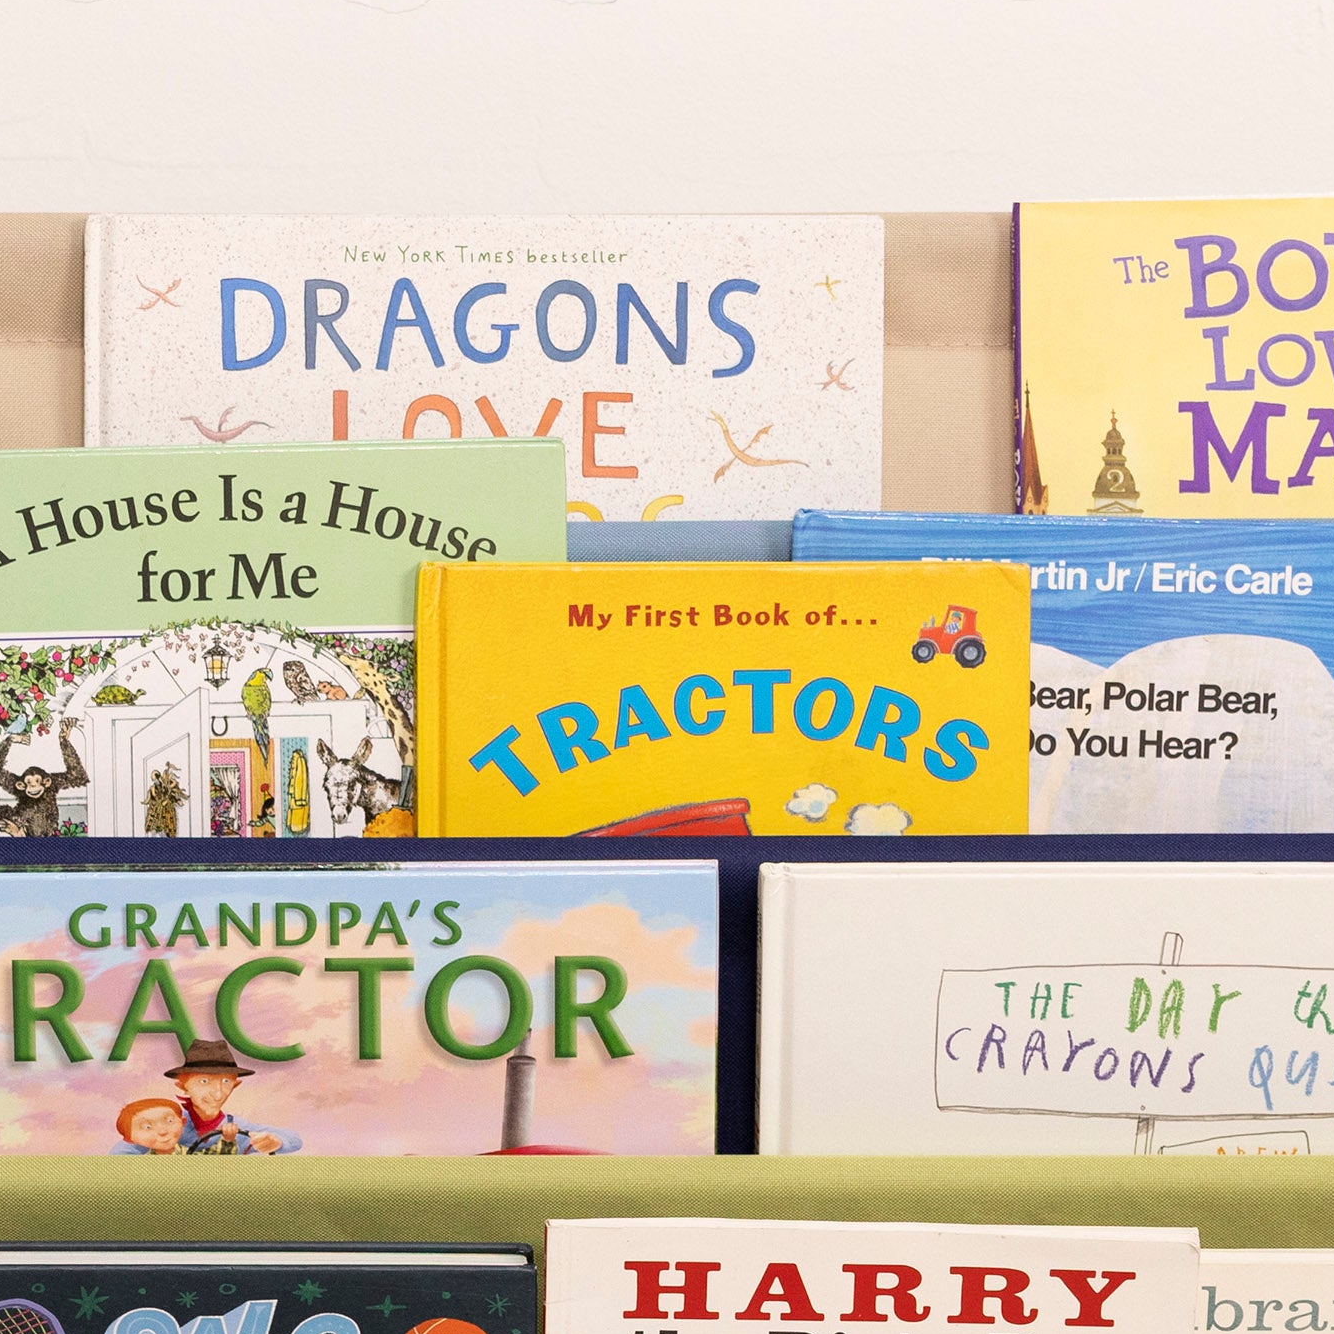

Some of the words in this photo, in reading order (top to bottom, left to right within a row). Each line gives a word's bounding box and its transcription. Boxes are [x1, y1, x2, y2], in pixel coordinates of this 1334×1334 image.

[527, 248, 627, 264] bestseller
[1113, 255, 1170, 285] The
[219, 277, 761, 379] DRAGONS
[1107, 469, 1126, 493] 2
[16, 487, 200, 555] House
[218, 474, 263, 522] Is
[279, 491, 308, 525] a
[321, 480, 498, 562] House
[137, 551, 216, 603] for
[228, 552, 319, 601] Me
[1095, 561, 1131, 592] Jr
[1152, 562, 1217, 595] Eric
[1225, 564, 1314, 597] Carle
[568, 604, 613, 631] My
[626, 604, 701, 628] First
[714, 603, 790, 627] Book
[1029, 679, 1091, 716] ear,
[1103, 682, 1189, 713] Polar
[1198, 684, 1278, 720] Bear,
[469, 669, 990, 798] TRACTORS
[1028, 728, 1057, 757] o
[1066, 728, 1131, 758] You
[1138, 729, 1239, 761] Hear?
[68, 899, 462, 949] GRANDPA'S
[995, 981, 1082, 1020] THE
[1125, 977, 1241, 1039] DAY
[945, 1023, 1205, 1093] CRAYONS
[622, 1260, 1136, 1328] HARRY
